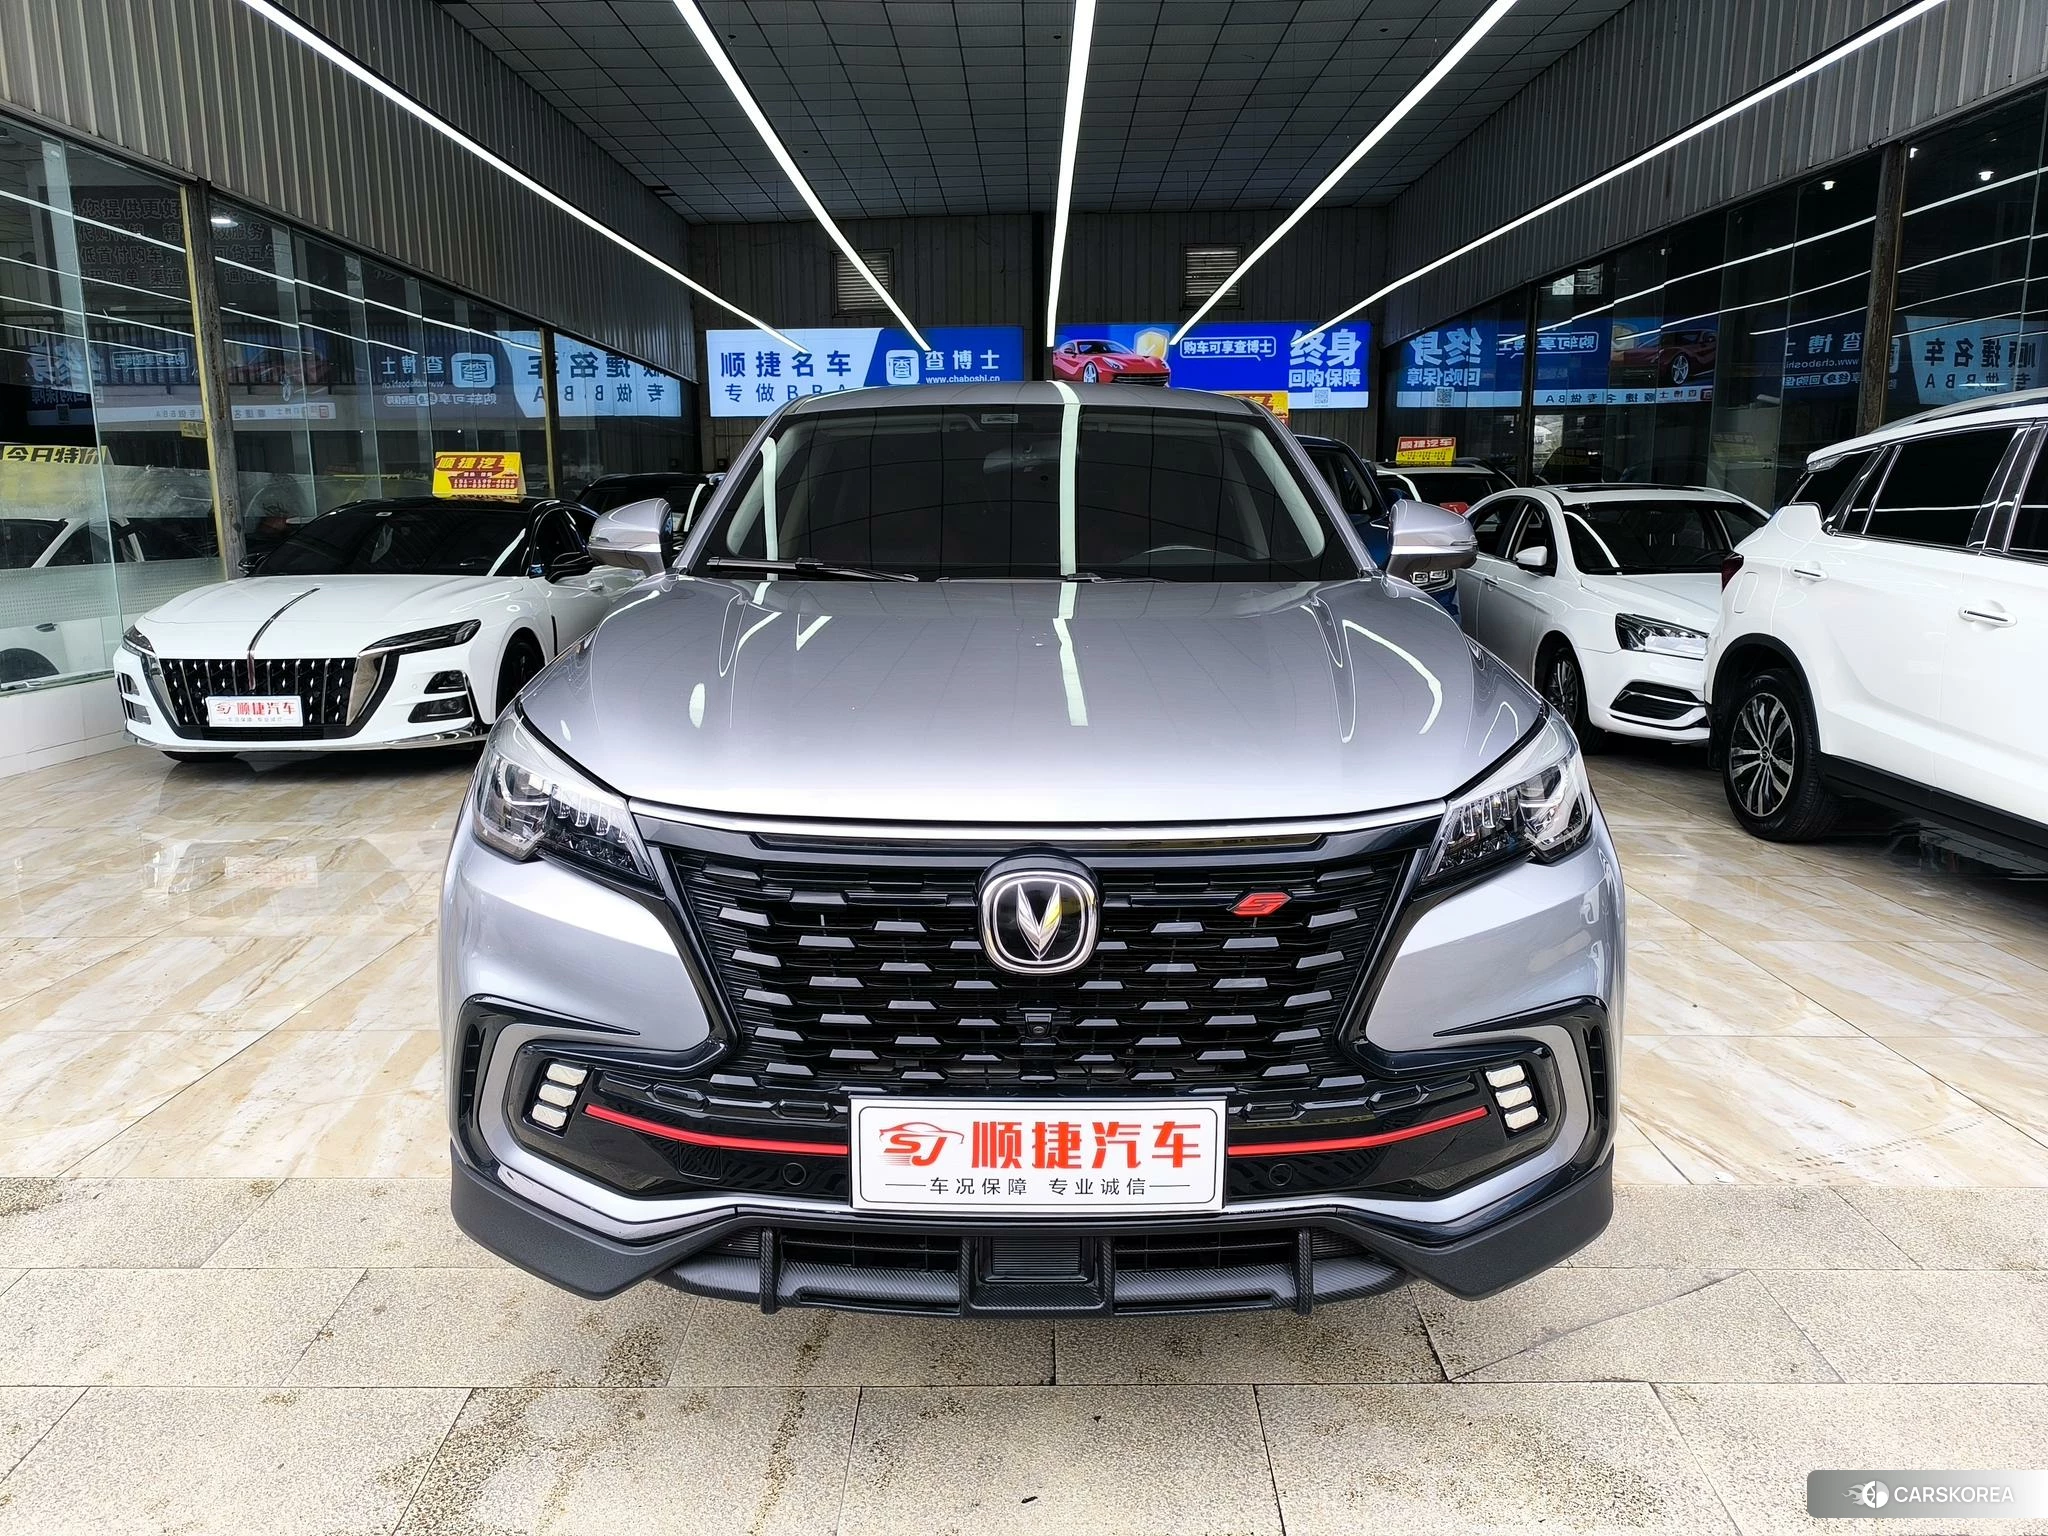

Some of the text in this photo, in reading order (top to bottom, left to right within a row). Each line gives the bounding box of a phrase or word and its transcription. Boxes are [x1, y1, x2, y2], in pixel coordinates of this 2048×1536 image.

[1183, 339, 1272, 355] 购车可享查博士
[1289, 328, 1362, 367] 终身
[720, 350, 852, 378] 顺捷名车
[925, 349, 1000, 370] 查博士
[925, 374, 1001, 384] www.chaboshi.cn
[1288, 368, 1361, 388] 回购保障
[882, 1134, 948, 1167] SJ
[971, 1120, 1201, 1170] 顺捷汽车
[929, 1177, 1147, 1196] 车况保障 专业诚信
